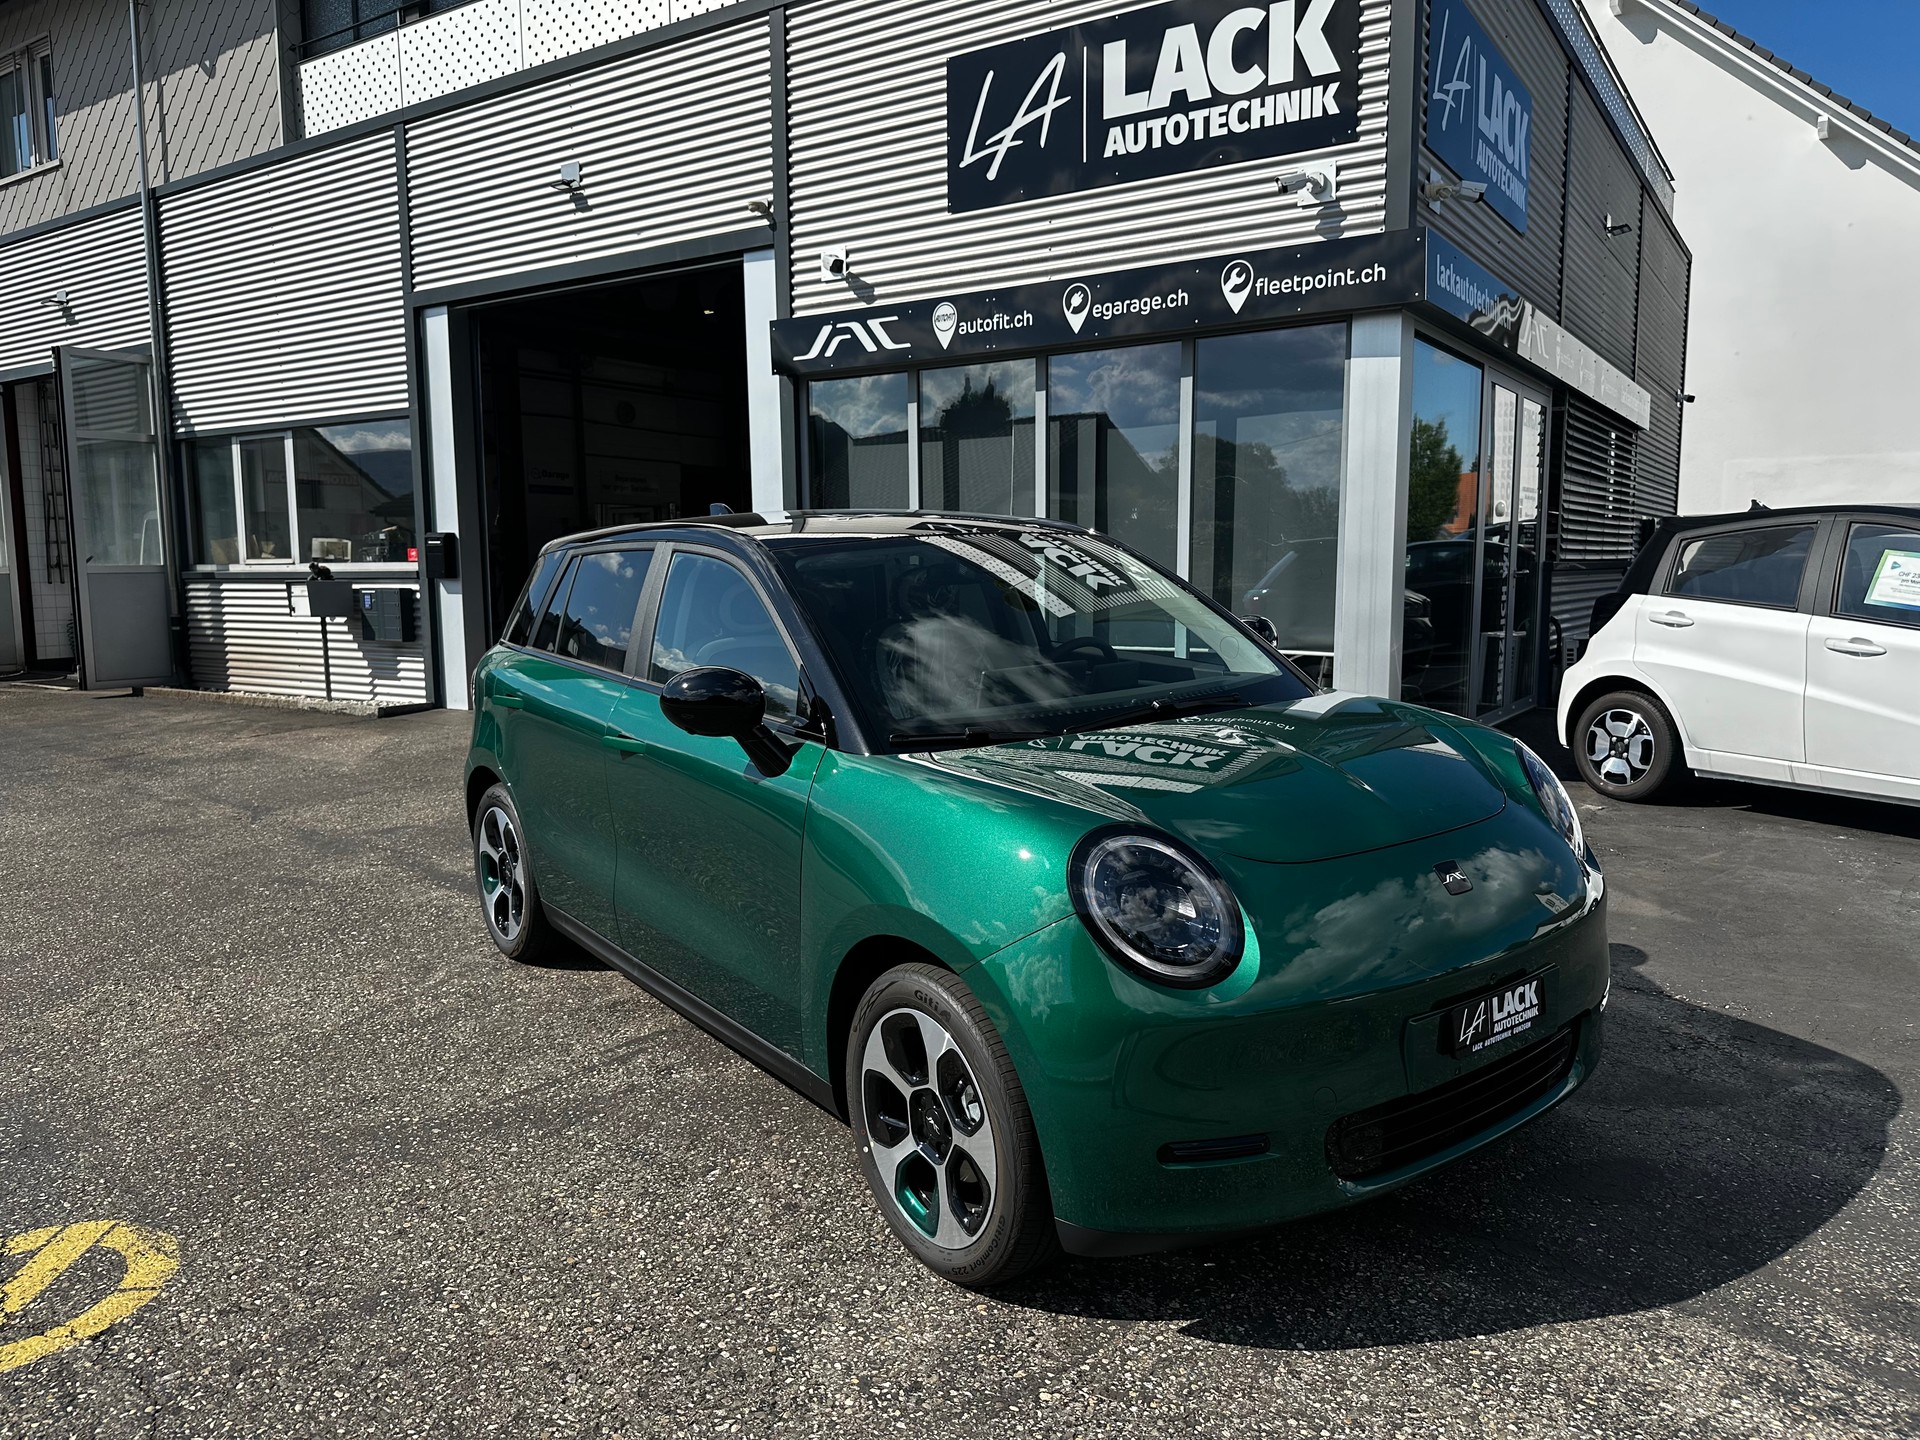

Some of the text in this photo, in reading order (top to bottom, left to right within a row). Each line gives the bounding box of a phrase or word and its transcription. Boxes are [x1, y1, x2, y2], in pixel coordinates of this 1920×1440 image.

[1103, 0, 1341, 120] LACK
[1103, 81, 1341, 159] AUTOTECHNIK
[1477, 54, 1529, 181] LACK
[1476, 138, 1527, 213] AUTOTECHNIK
[1255, 262, 1386, 295] fleetpoint.ch
[958, 310, 1033, 335] autofit.ch
[1092, 289, 1189, 320] egarage.ch
[792, 315, 912, 361] JAC
[914, 990, 939, 1011] Giti
[1492, 980, 1539, 1022] LACK
[1493, 1005, 1539, 1034] AUTOTECHNIK
